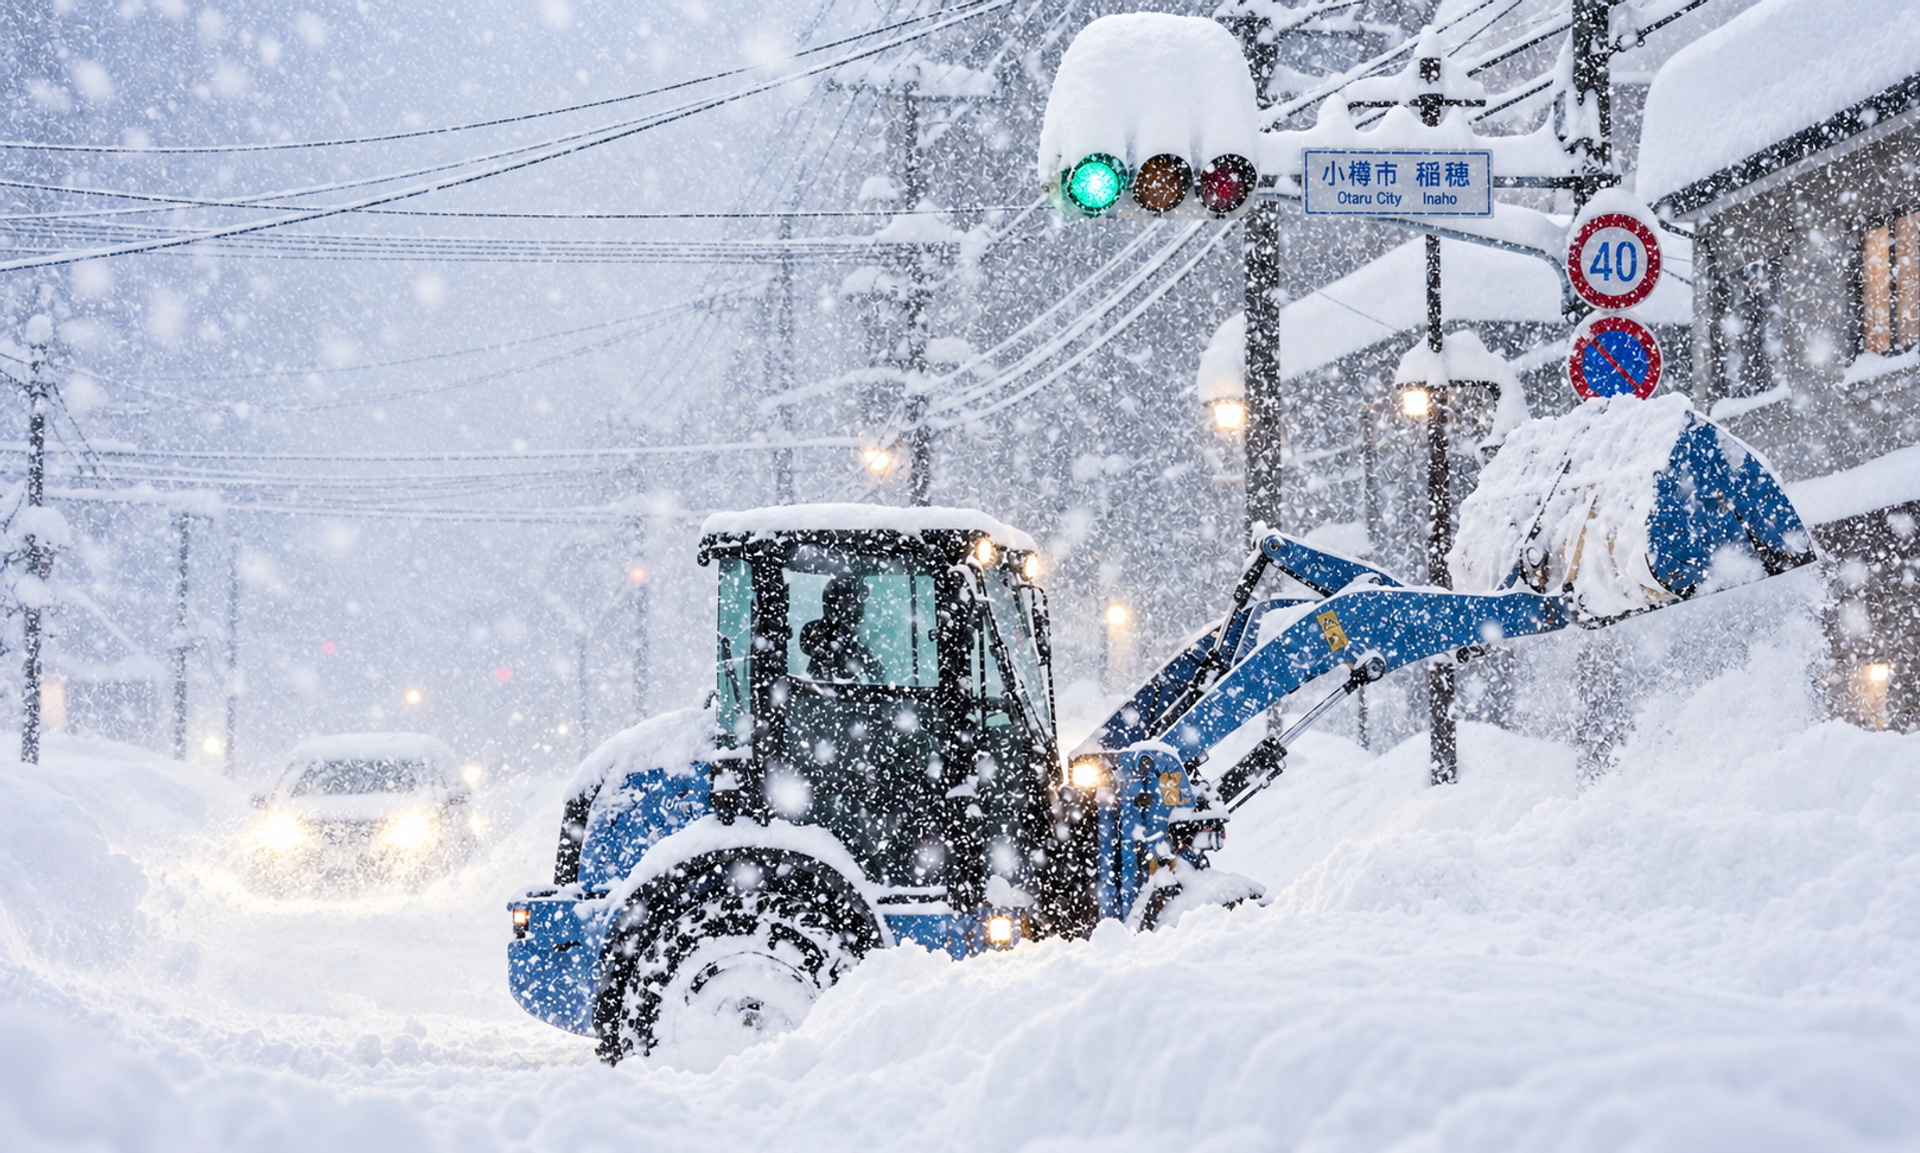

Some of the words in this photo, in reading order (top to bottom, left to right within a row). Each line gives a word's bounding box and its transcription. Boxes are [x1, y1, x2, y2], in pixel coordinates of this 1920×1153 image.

[1321, 160, 1399, 188] 小樽市
[1415, 160, 1471, 188] 稲穂
[1337, 190, 1373, 205] Otaru
[1376, 191, 1403, 208] City
[1422, 191, 1458, 206] Inaho
[1589, 240, 1638, 283] 40
